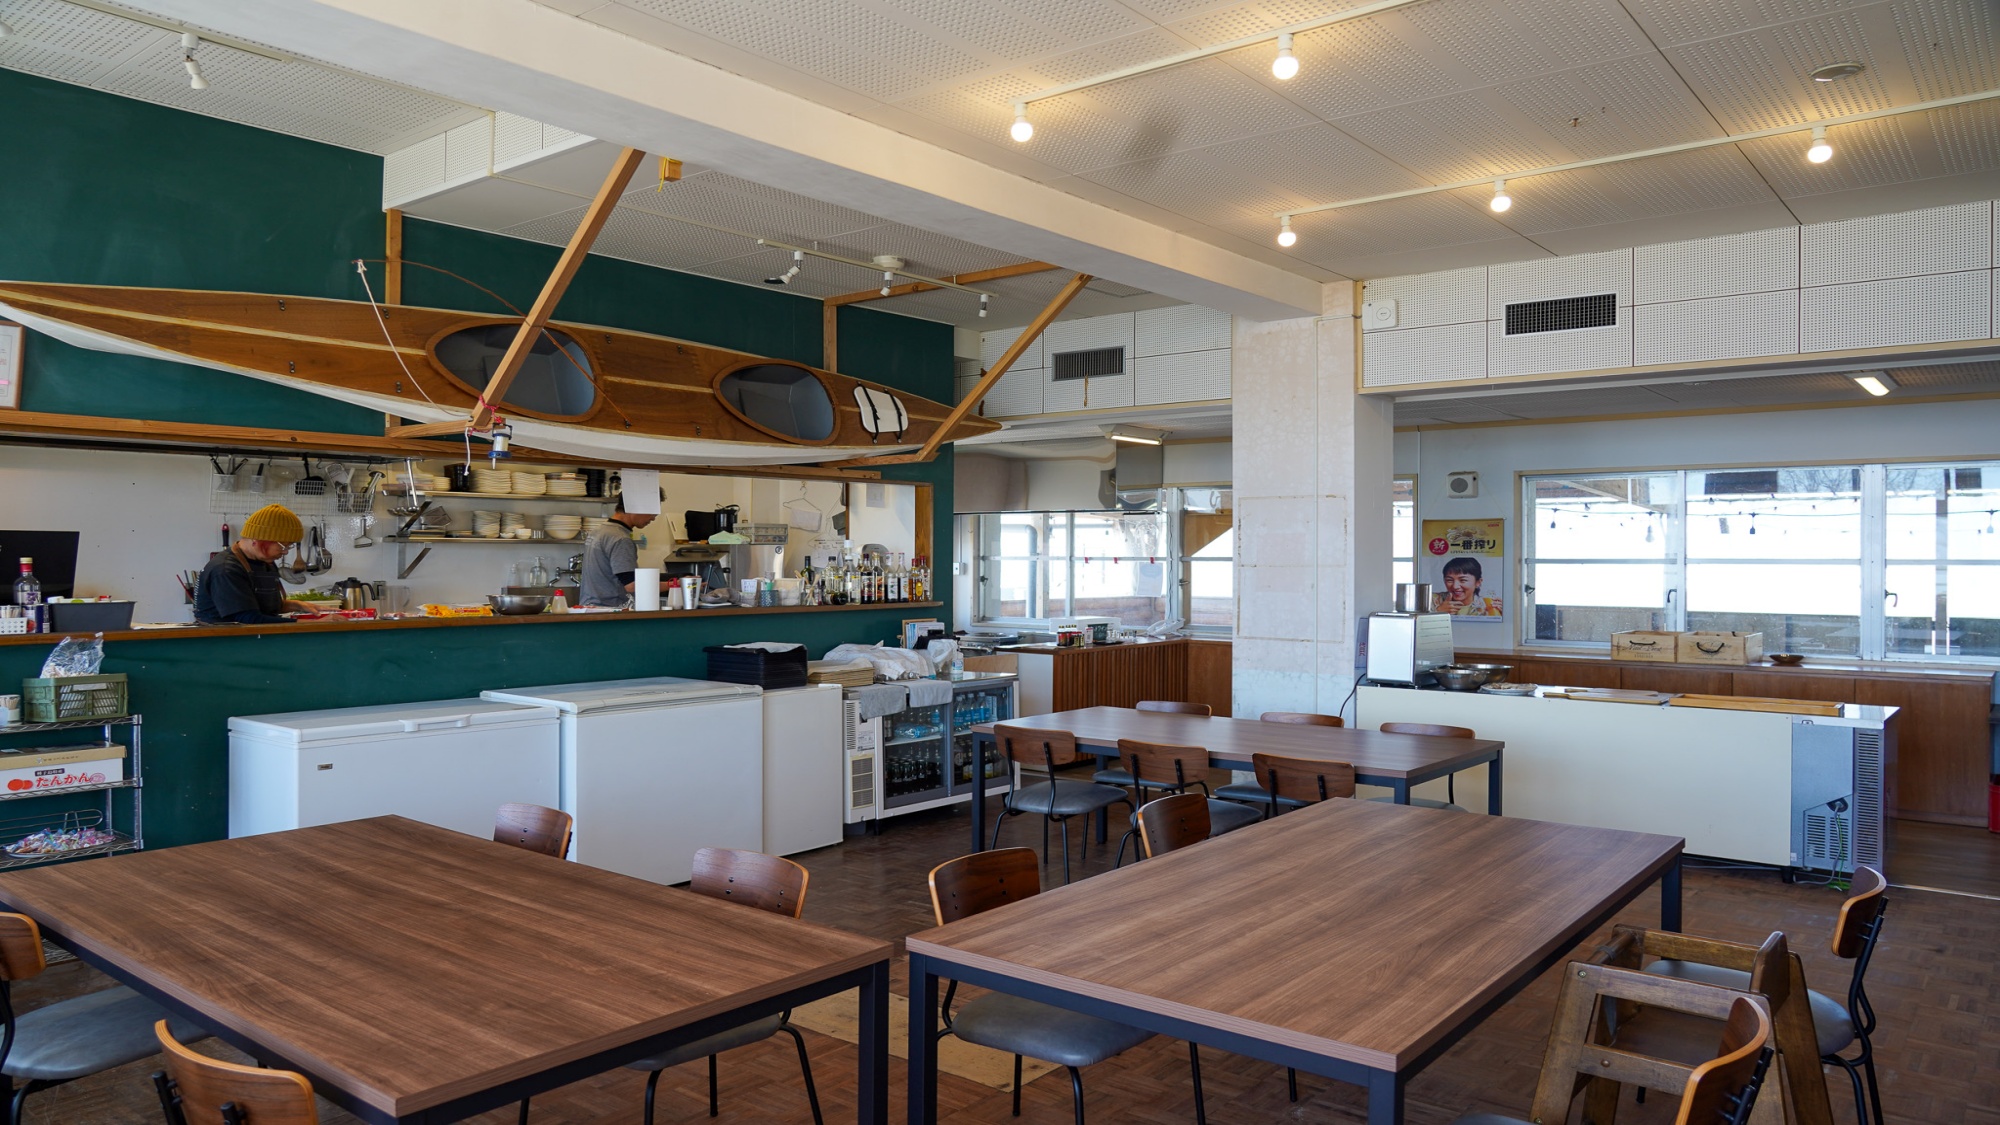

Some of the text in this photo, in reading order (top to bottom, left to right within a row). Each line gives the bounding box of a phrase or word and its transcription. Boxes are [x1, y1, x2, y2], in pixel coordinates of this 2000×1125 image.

[1450, 539, 1496, 549] 一番搾り
[36, 772, 91, 787] たんかん
